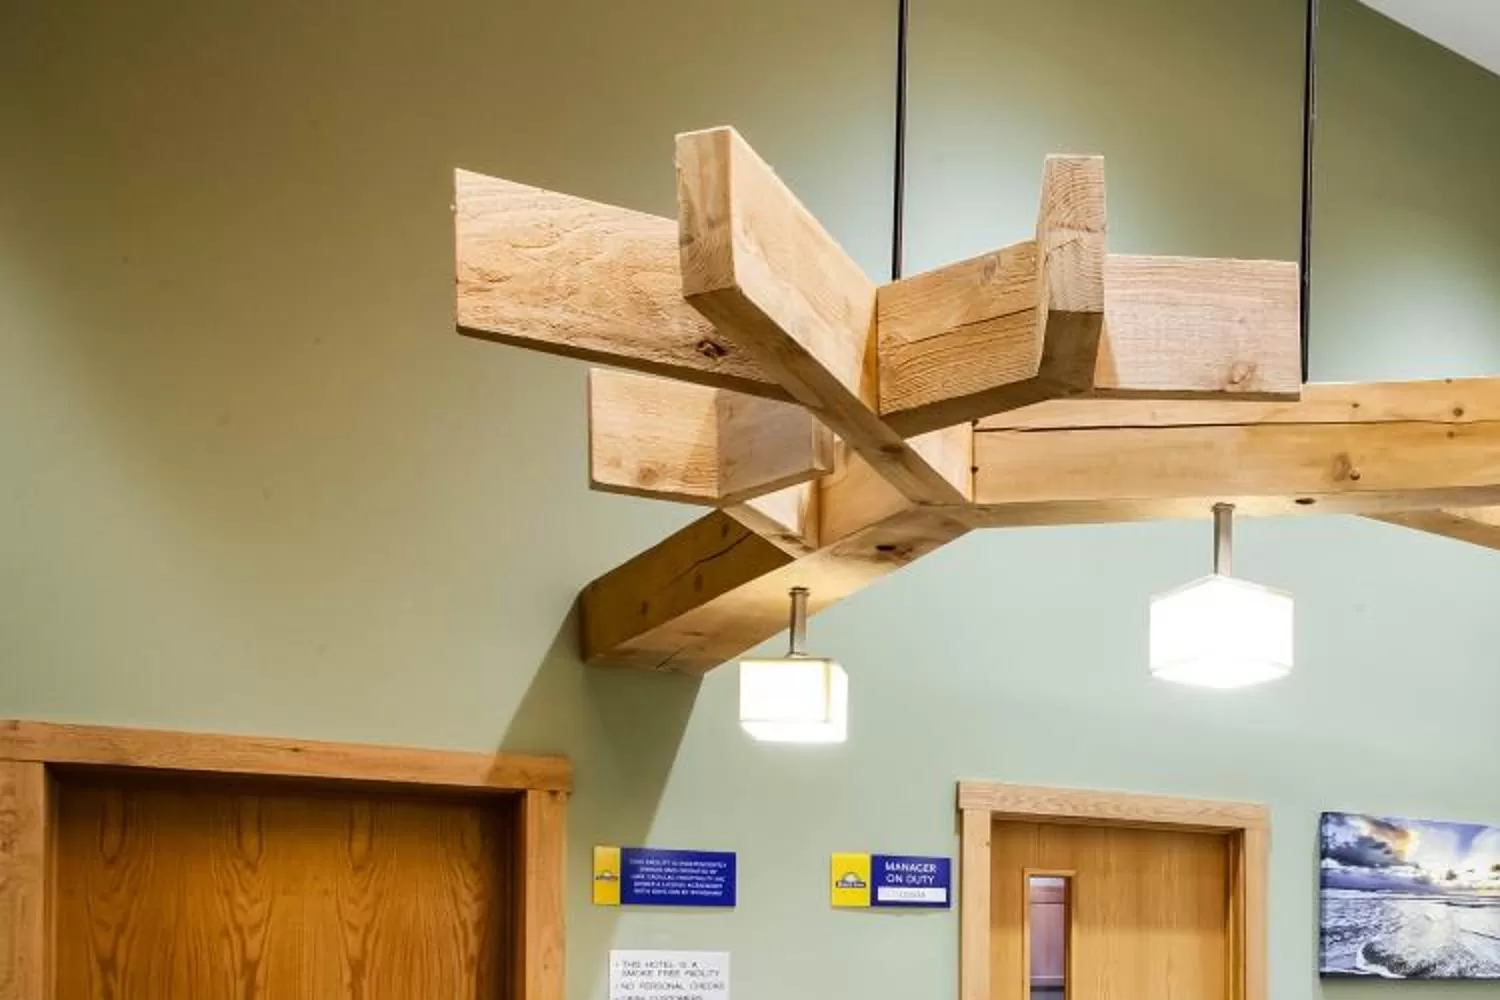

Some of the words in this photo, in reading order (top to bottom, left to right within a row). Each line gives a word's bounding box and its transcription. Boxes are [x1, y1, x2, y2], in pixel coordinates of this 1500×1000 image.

[885, 861, 936, 873] MANAGER
[885, 874, 903, 884] ON
[905, 875, 935, 885] DUTY
